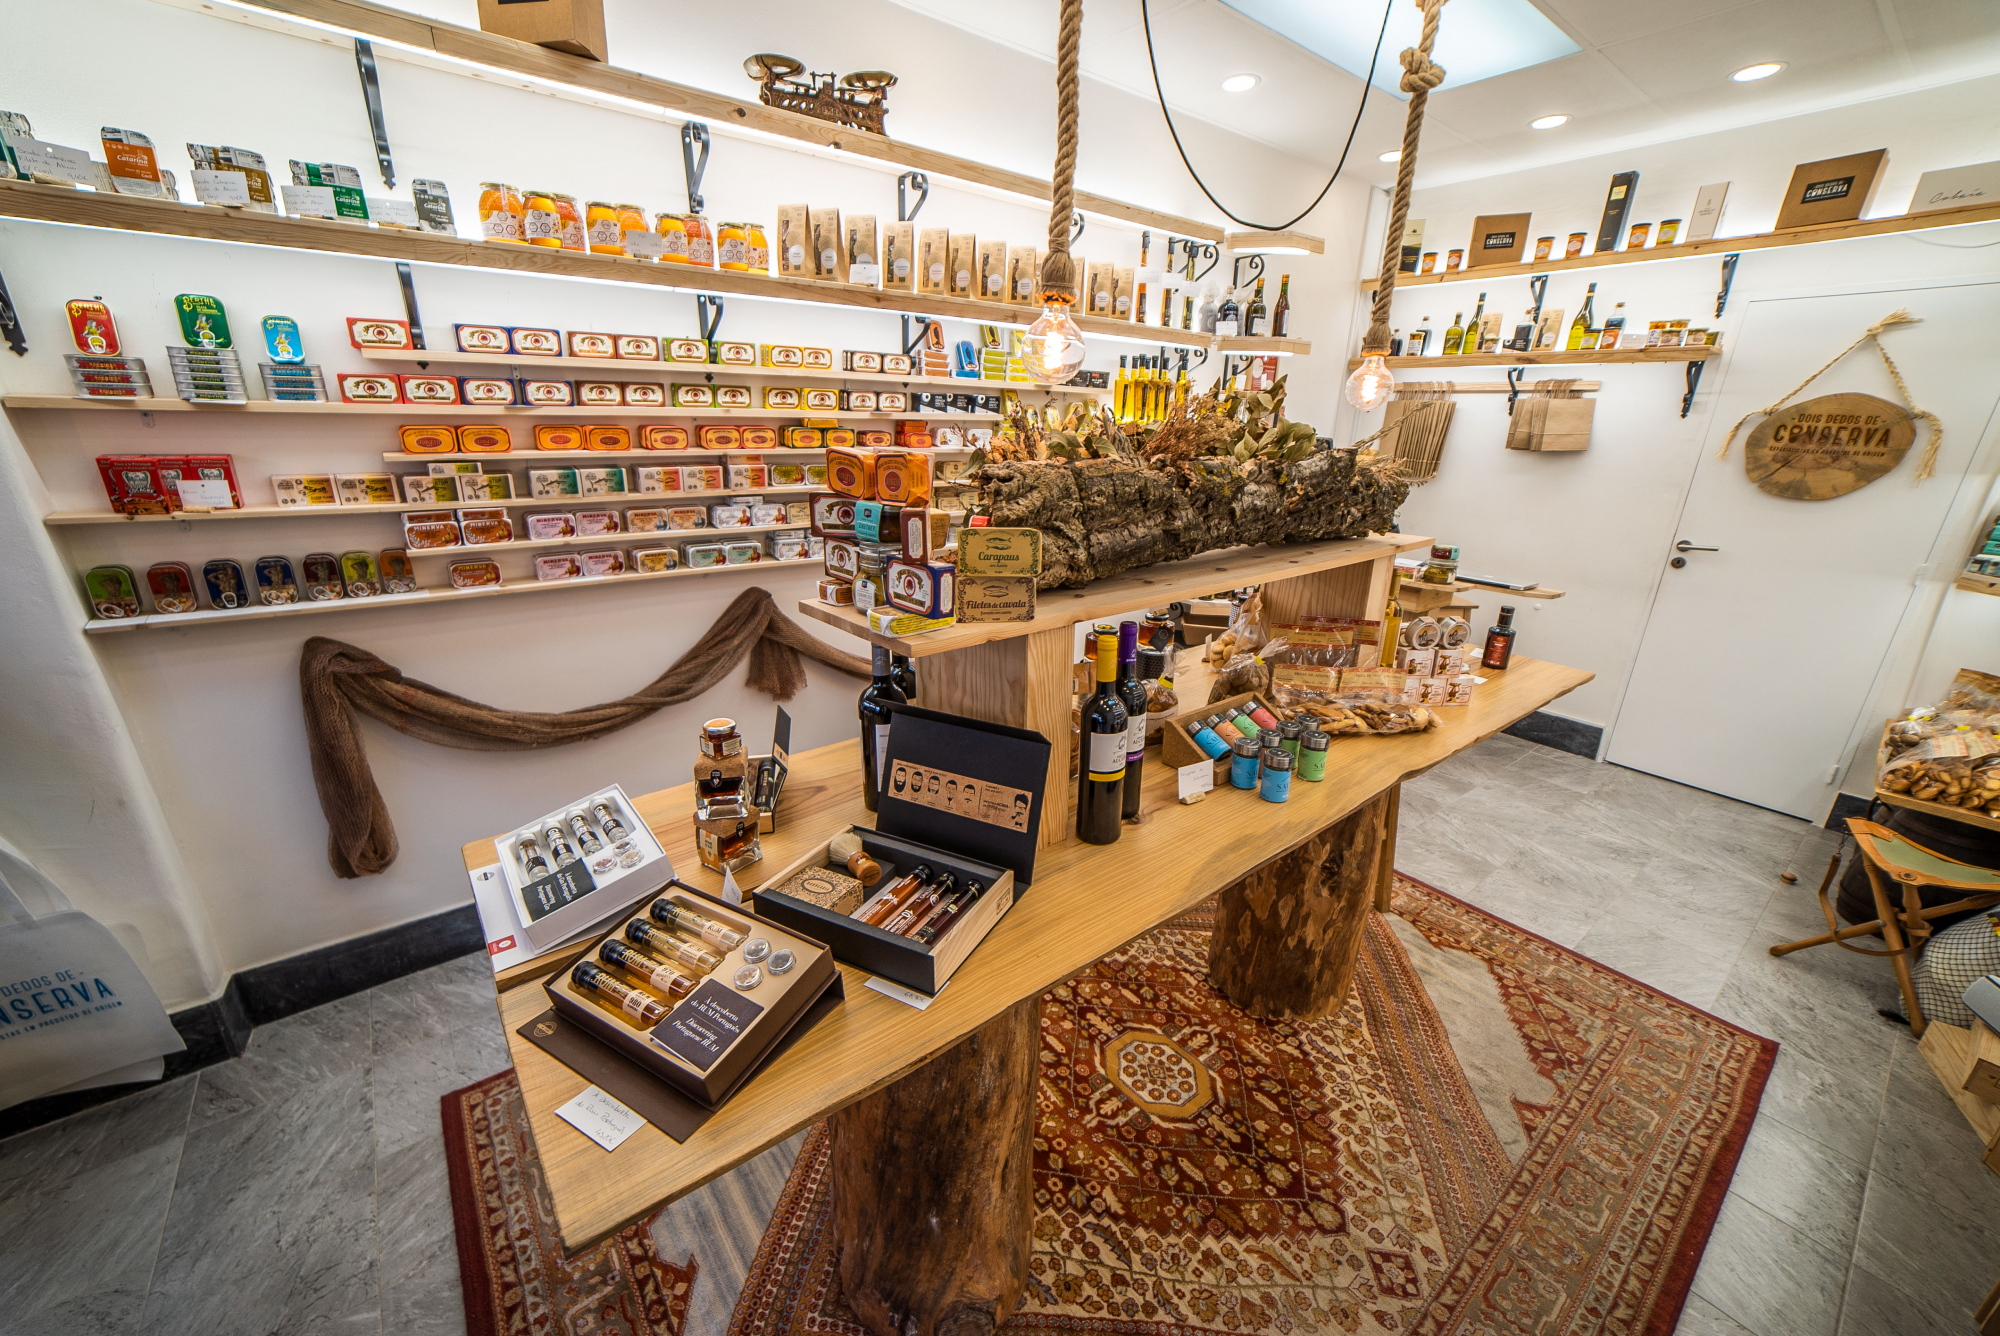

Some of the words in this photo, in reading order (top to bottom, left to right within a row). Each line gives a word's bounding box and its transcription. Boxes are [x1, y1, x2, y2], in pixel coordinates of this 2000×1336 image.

[117, 154, 148, 164] Catarina
[336, 195, 360, 204] Catarina
[423, 203, 446, 212] Catarina
[182, 296, 217, 312] BERTHE
[1798, 413, 1823, 423] DOIS
[1826, 414, 1862, 424] DEDOS
[1865, 415, 1881, 425] DE
[1773, 424, 1893, 449] CONSERVA
[978, 551, 1019, 564] Carapaus
[966, 601, 991, 609] Filetes
[999, 600, 1026, 608] cavala
[707, 923, 724, 934] RUM
[0, 976, 52, 997] DEDOS
[55, 969, 76, 982] DE
[593, 973, 620, 992] RUM
[628, 996, 642, 1008] 980
[24, 1025, 36, 1033] EM
[39, 1012, 80, 1028] PRODUTOS
[82, 1008, 92, 1016] DE
[94, 1001, 123, 1012] ORIGEM
[698, 1004, 716, 1017] RUM
[712, 1012, 740, 1034] Português
[709, 1000, 739, 1022] descoberta
[672, 1020, 703, 1042] Portuguese
[700, 1038, 720, 1053] RUM
[686, 1018, 718, 1041] Discovering
